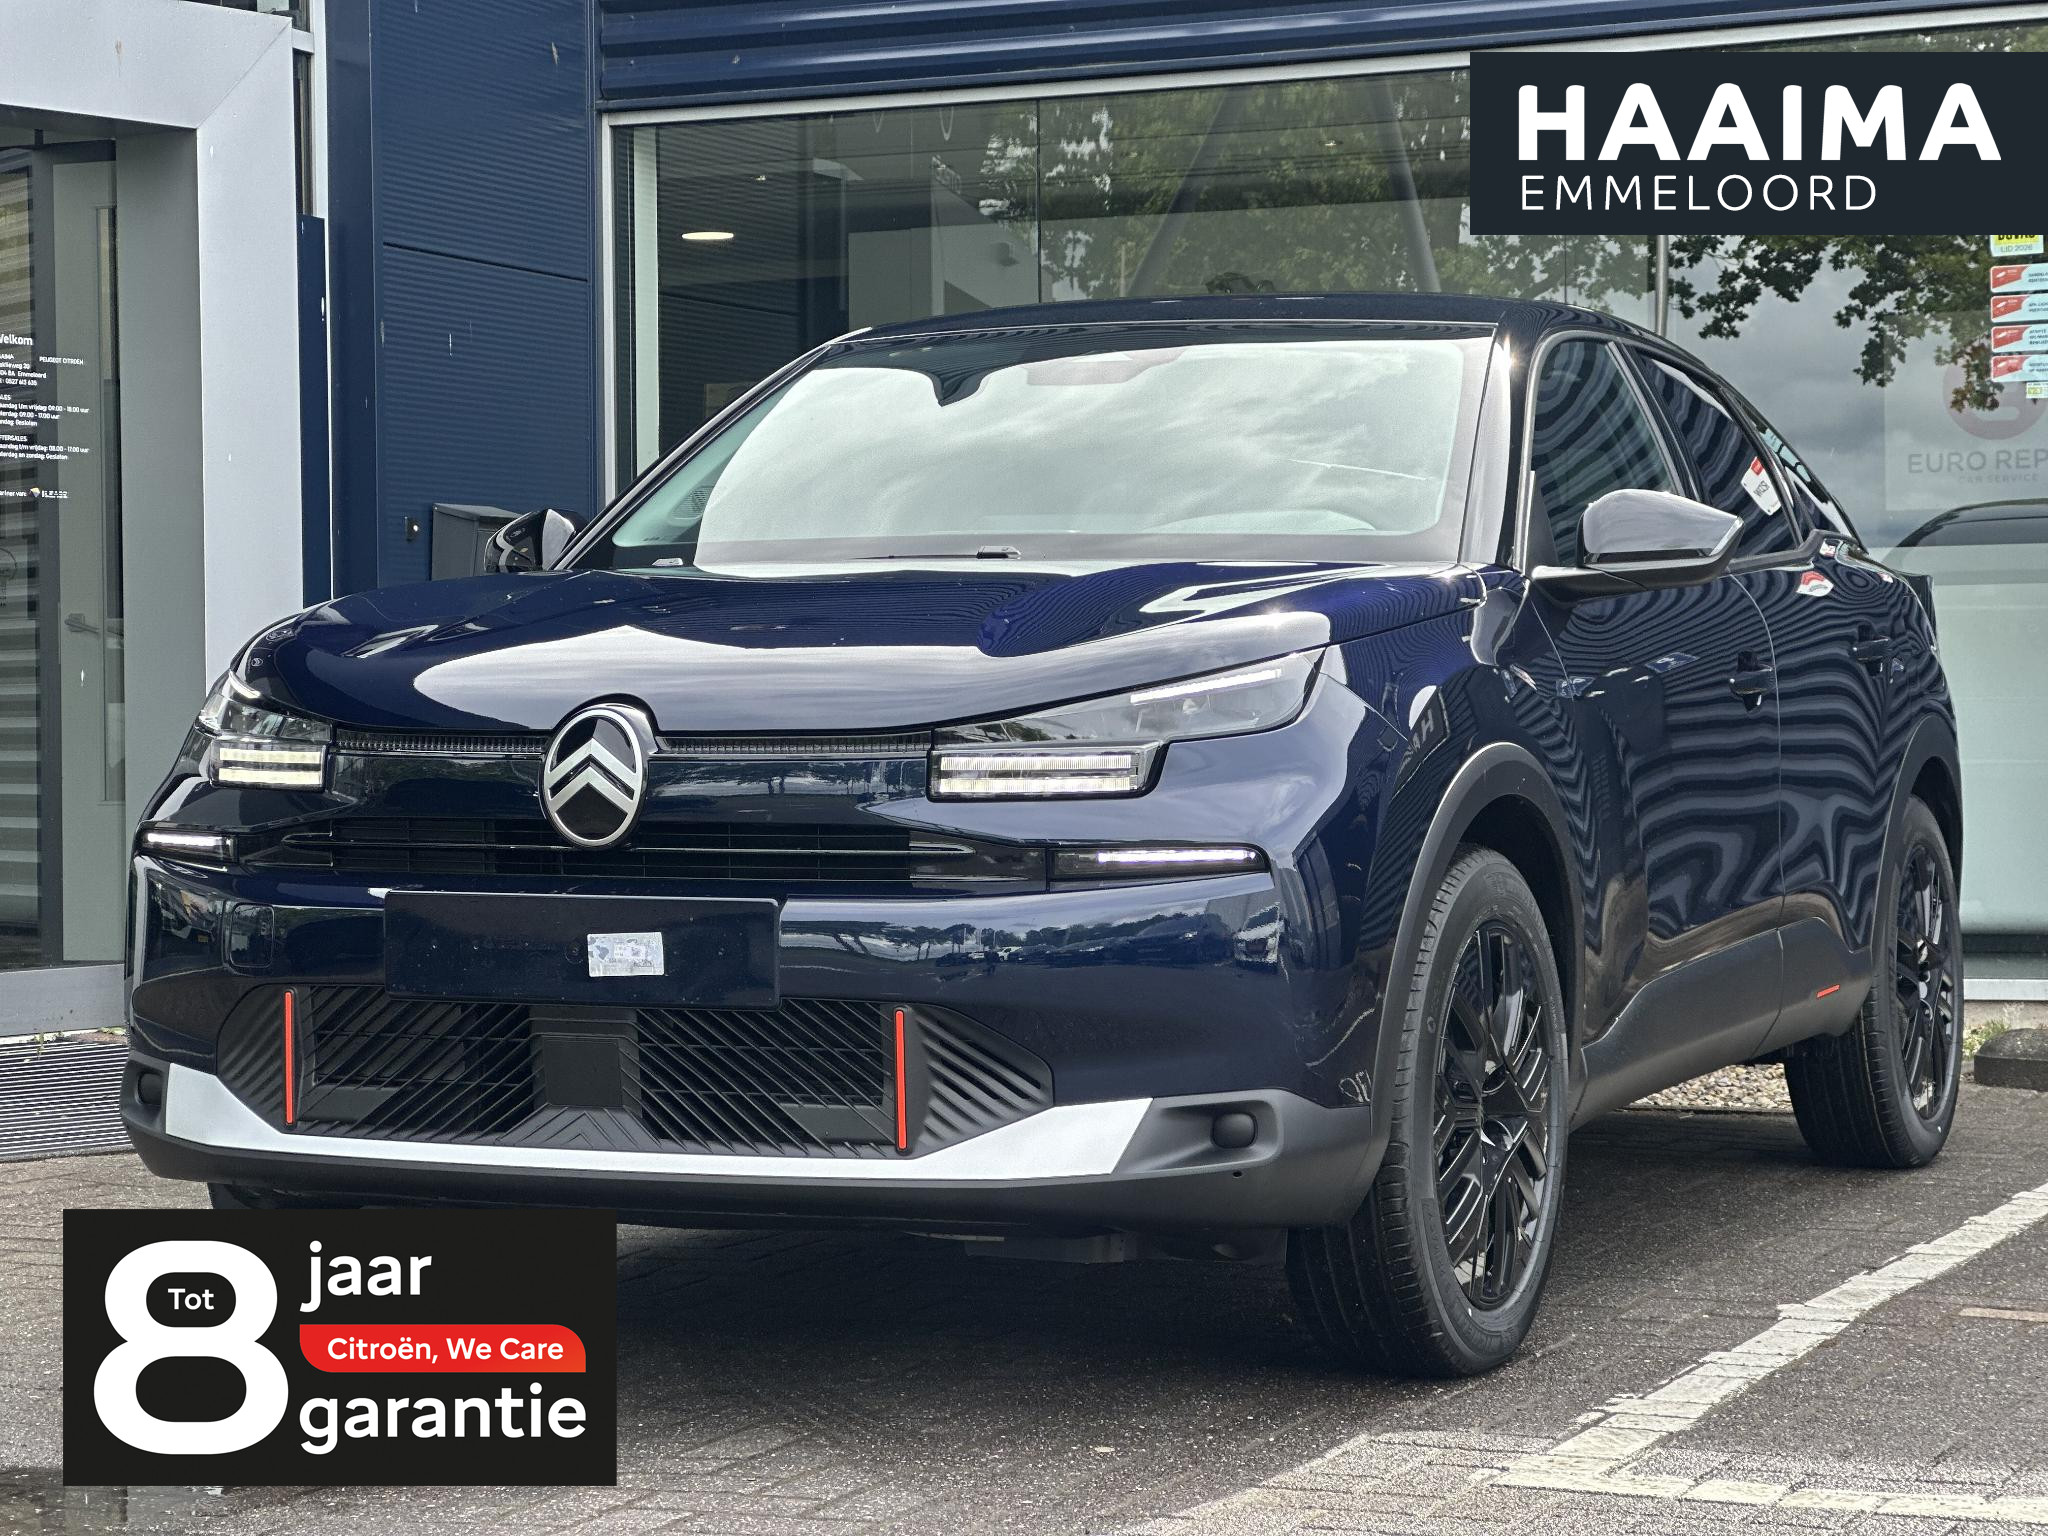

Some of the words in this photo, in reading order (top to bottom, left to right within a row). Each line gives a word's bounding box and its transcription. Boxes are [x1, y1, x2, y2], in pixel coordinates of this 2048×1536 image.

[1908, 451, 1987, 474] EURO
[1995, 448, 2048, 470] REP
[1960, 475, 1981, 483] CAR
[1987, 473, 2040, 483] SERVICE
